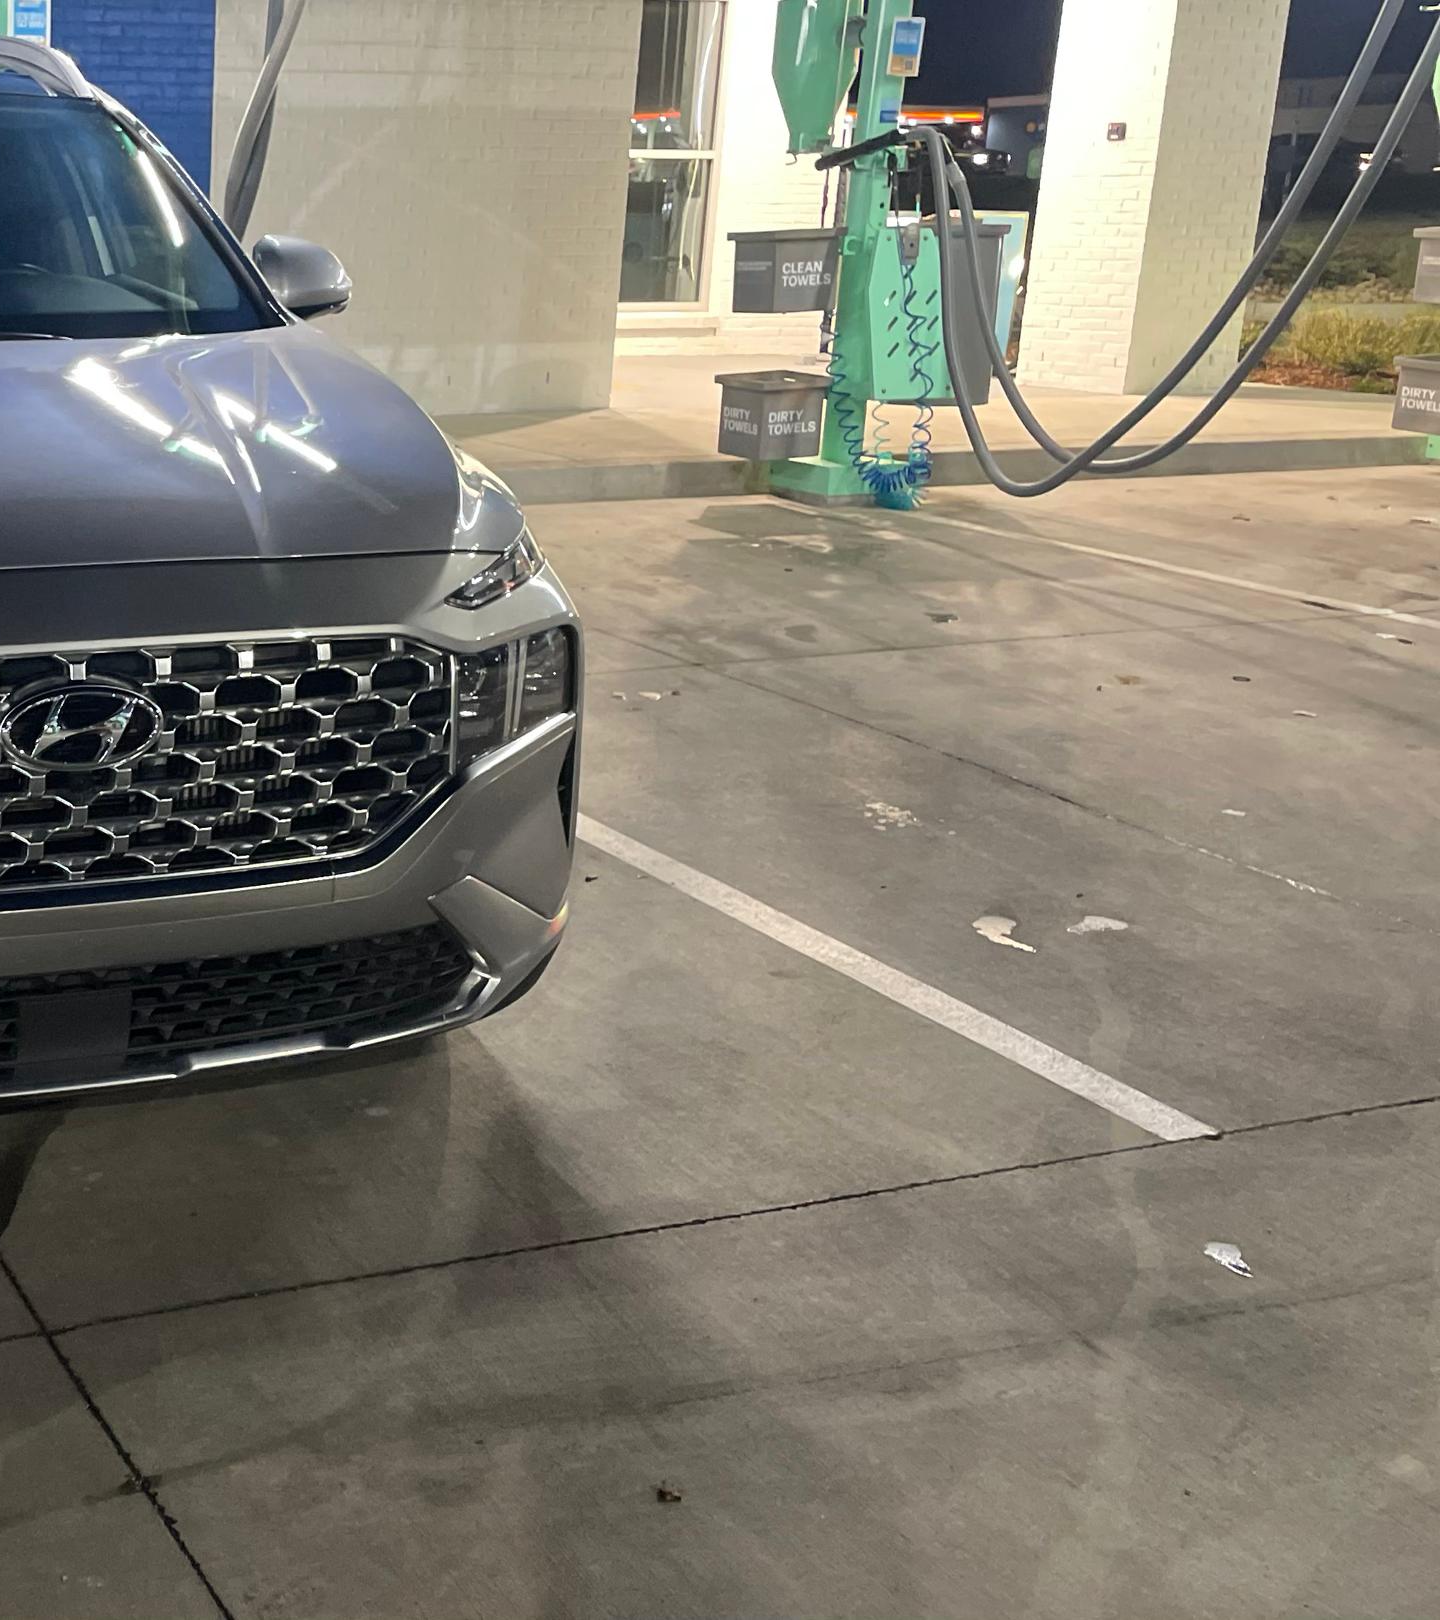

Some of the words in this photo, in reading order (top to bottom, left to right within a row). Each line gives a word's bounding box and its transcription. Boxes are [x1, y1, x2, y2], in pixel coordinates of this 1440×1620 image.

[782, 261, 823, 274] CLEAN
[782, 273, 831, 287] TOWELS
[1401, 386, 1436, 400] DIRTY
[1401, 397, 1440, 412] TOWEL
[723, 406, 750, 420] DIRTY
[768, 409, 804, 423] DIRTY
[723, 419, 758, 435] TOWELS
[768, 421, 816, 435] TOWELS
